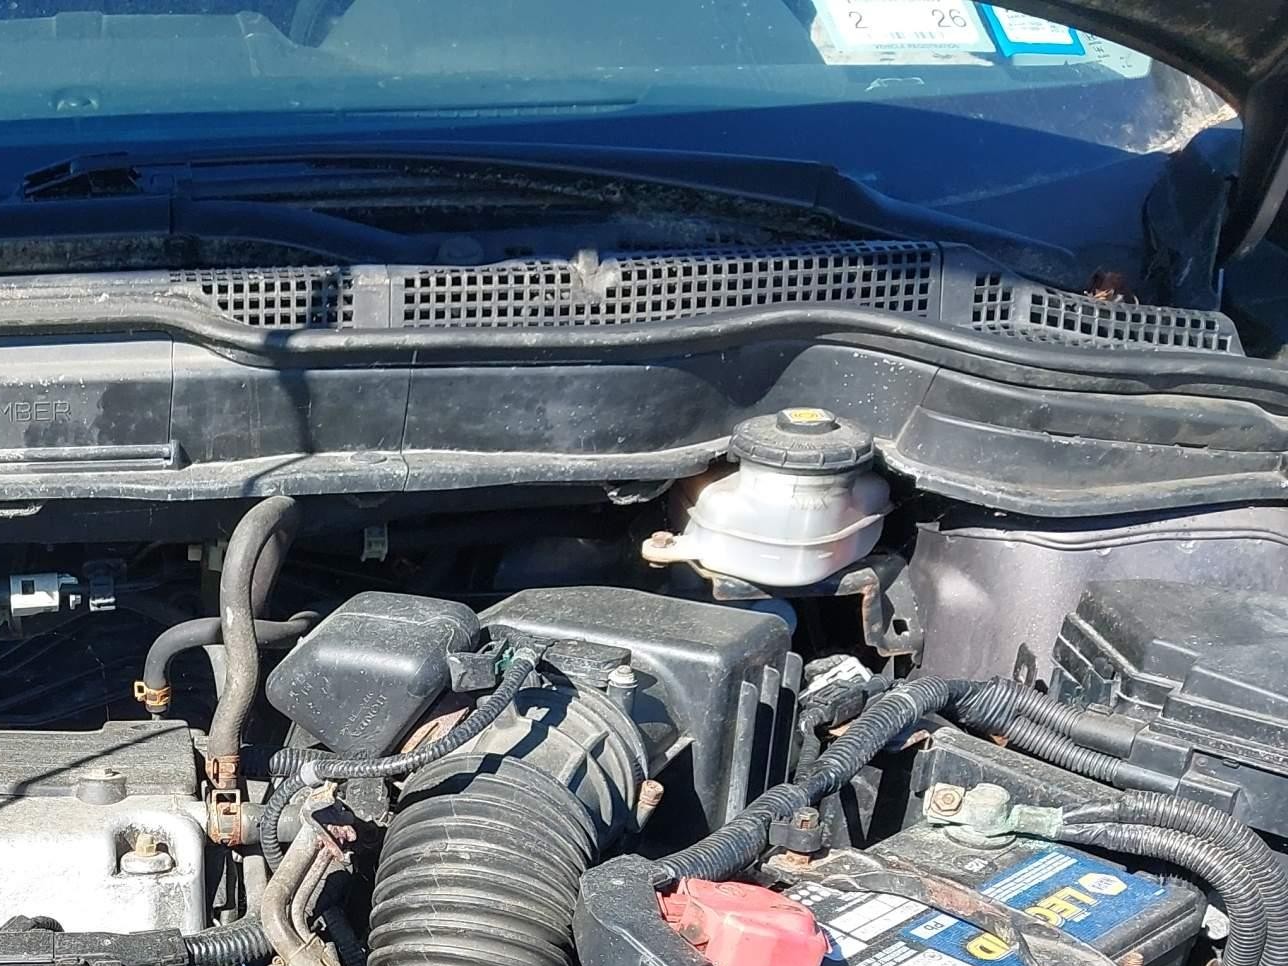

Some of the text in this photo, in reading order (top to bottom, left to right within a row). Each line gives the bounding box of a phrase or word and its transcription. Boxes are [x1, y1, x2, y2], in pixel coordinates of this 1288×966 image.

[848, 9, 967, 28] 2 26
[923, 920, 944, 931] Pb
